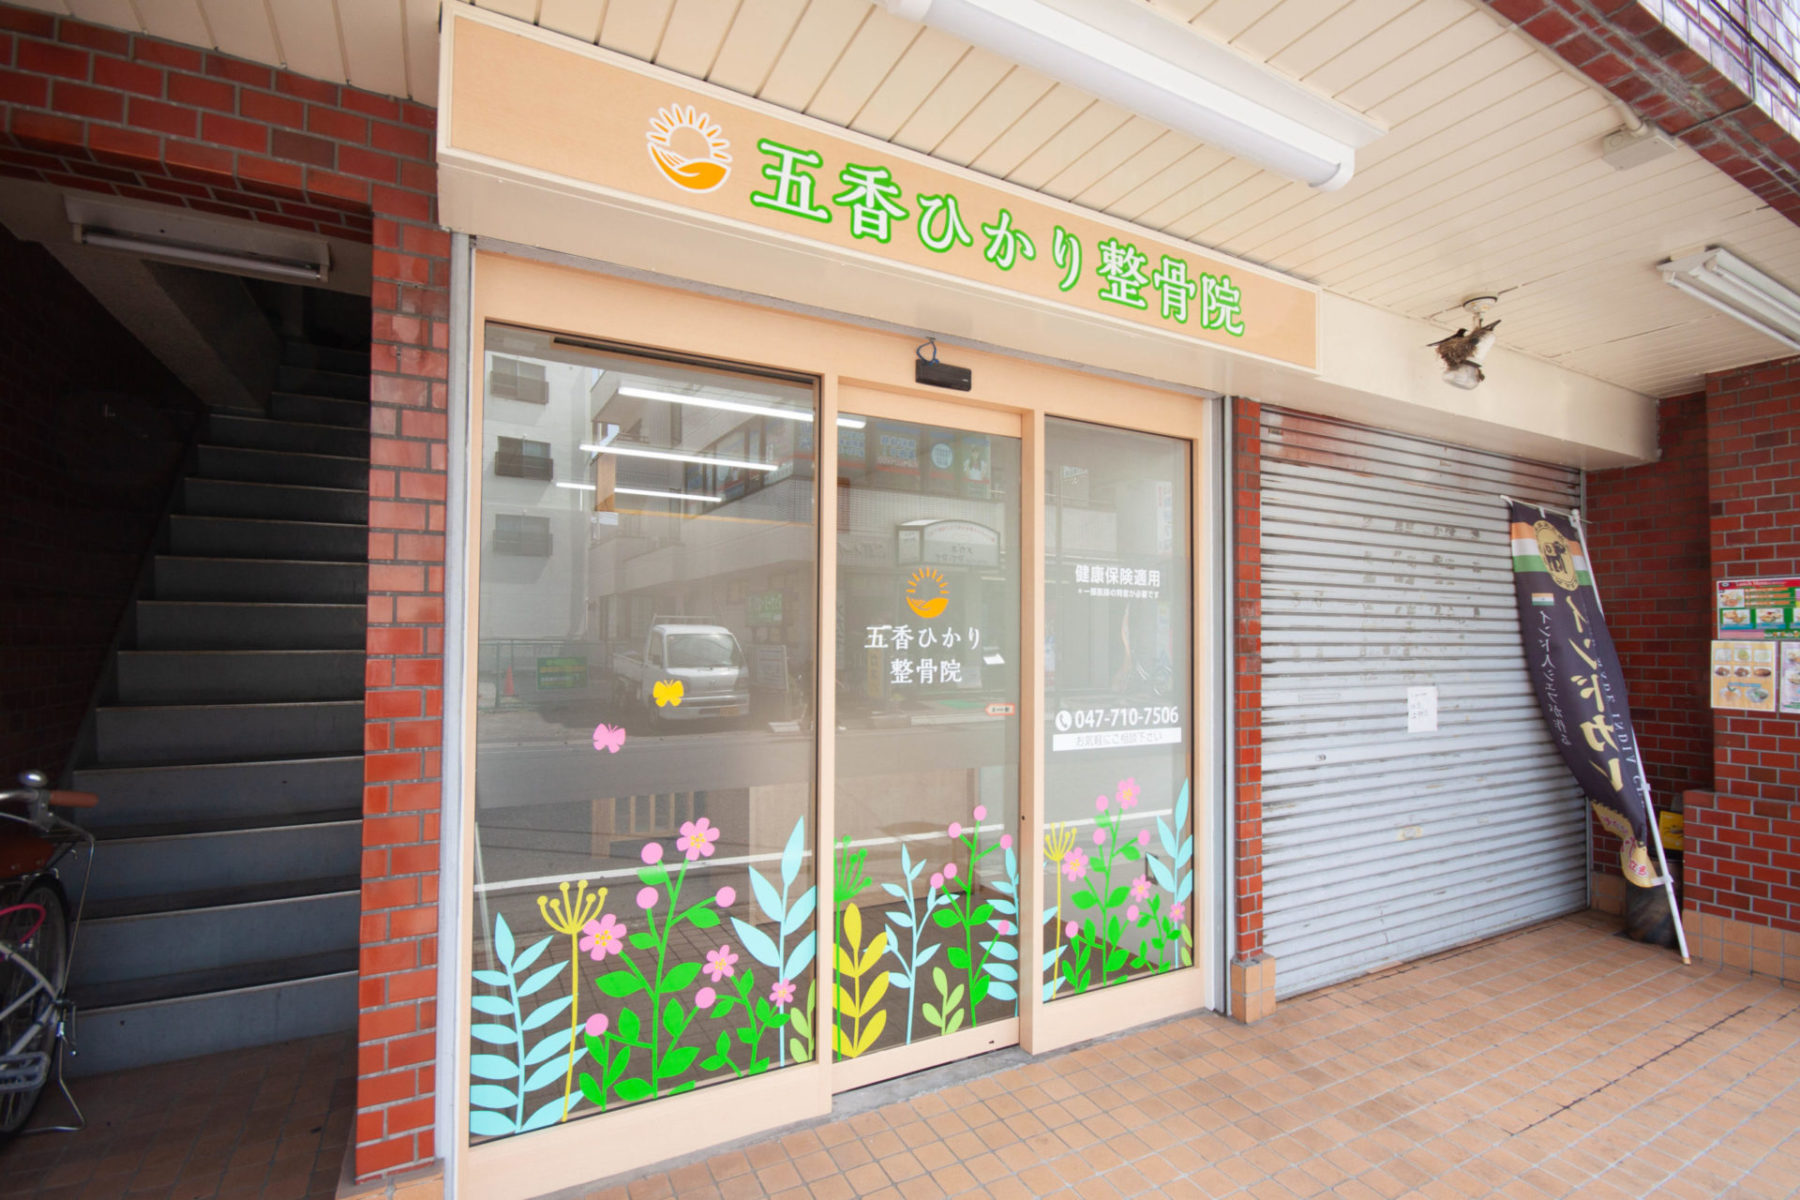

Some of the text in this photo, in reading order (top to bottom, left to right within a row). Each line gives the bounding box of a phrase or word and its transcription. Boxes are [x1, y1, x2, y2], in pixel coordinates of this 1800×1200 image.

[751, 139, 1245, 337] 五香ひかり整骨院
[1075, 564, 1161, 588] 健康保険適用
[864, 625, 981, 650] 五香ひかり
[890, 658, 963, 685] 整骨院
[1075, 705, 1180, 729] 047-710-7506
